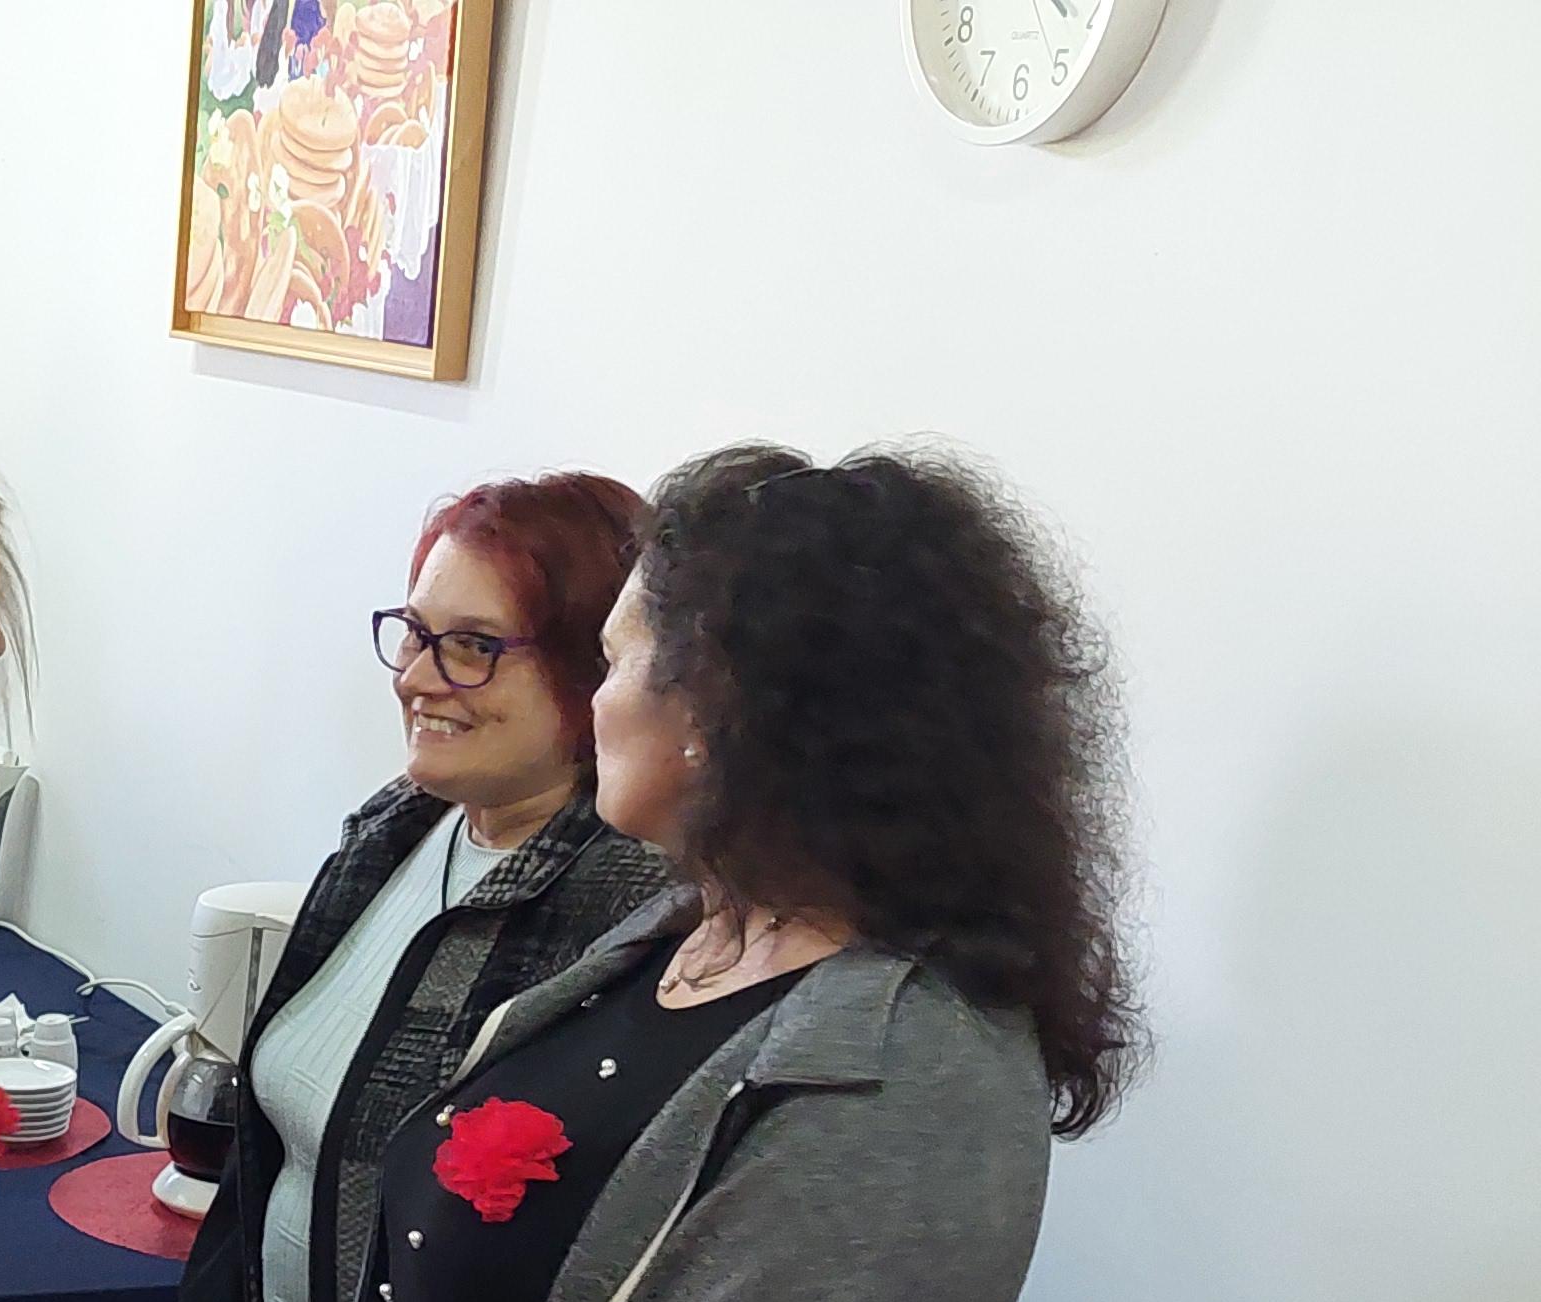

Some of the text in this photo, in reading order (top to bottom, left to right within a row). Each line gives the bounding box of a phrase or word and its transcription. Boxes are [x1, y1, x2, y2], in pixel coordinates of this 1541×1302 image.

[958, 6, 973, 43] 8
[980, 51, 996, 87] 7
[1013, 64, 1029, 101] 6
[1051, 49, 1069, 86] 5
